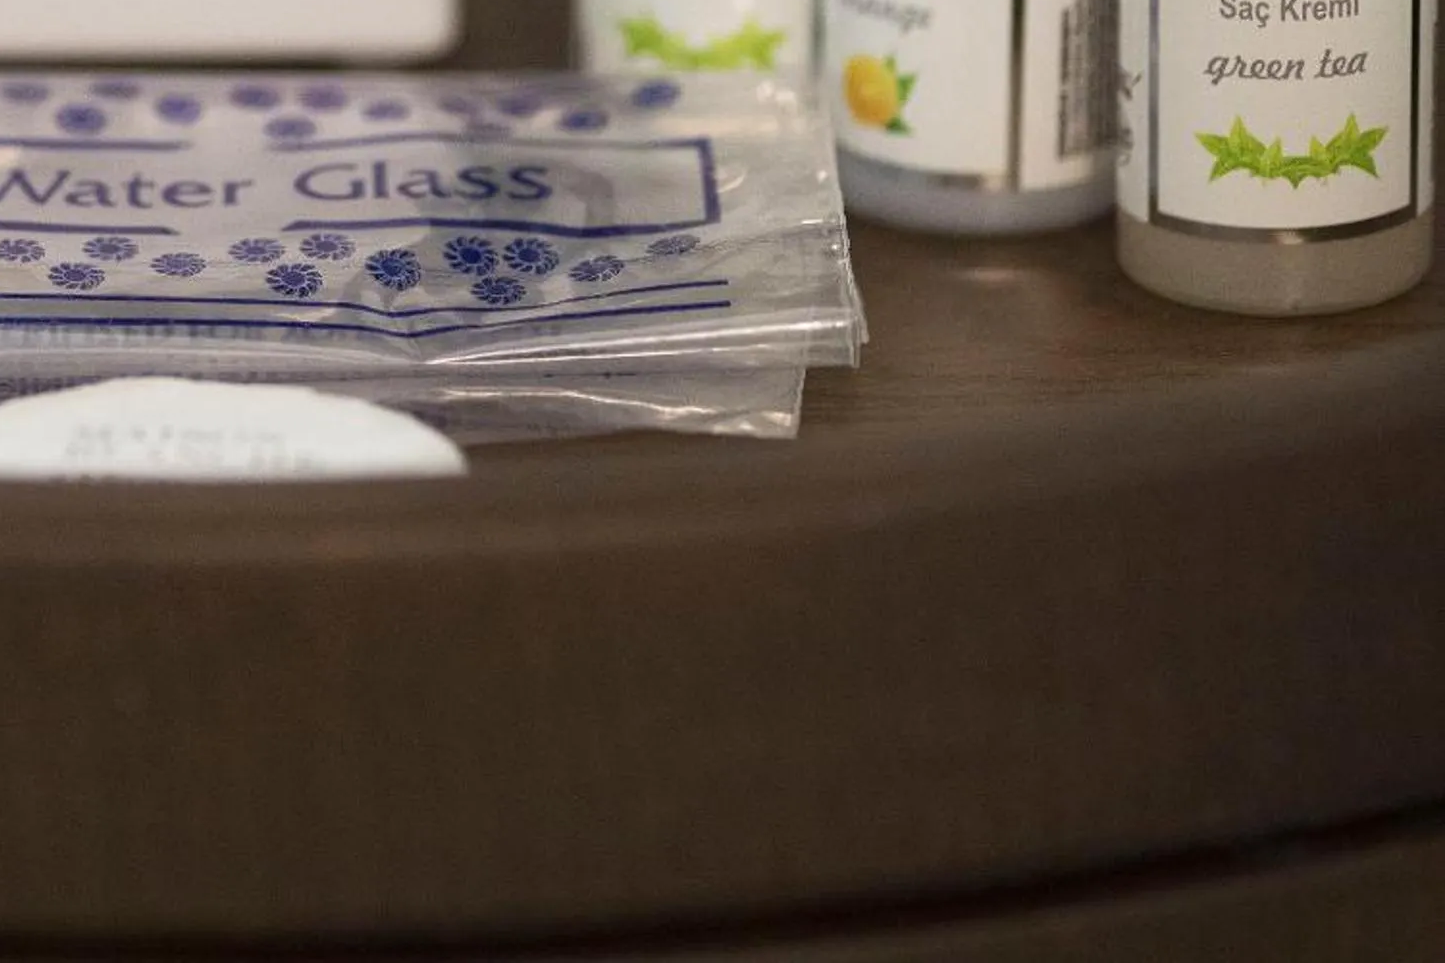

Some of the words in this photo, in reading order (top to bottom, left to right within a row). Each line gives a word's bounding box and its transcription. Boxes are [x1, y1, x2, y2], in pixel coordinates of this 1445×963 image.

[1204, 53, 1306, 85] green
[1313, 48, 1369, 79] tea
[292, 160, 554, 202] Glass
